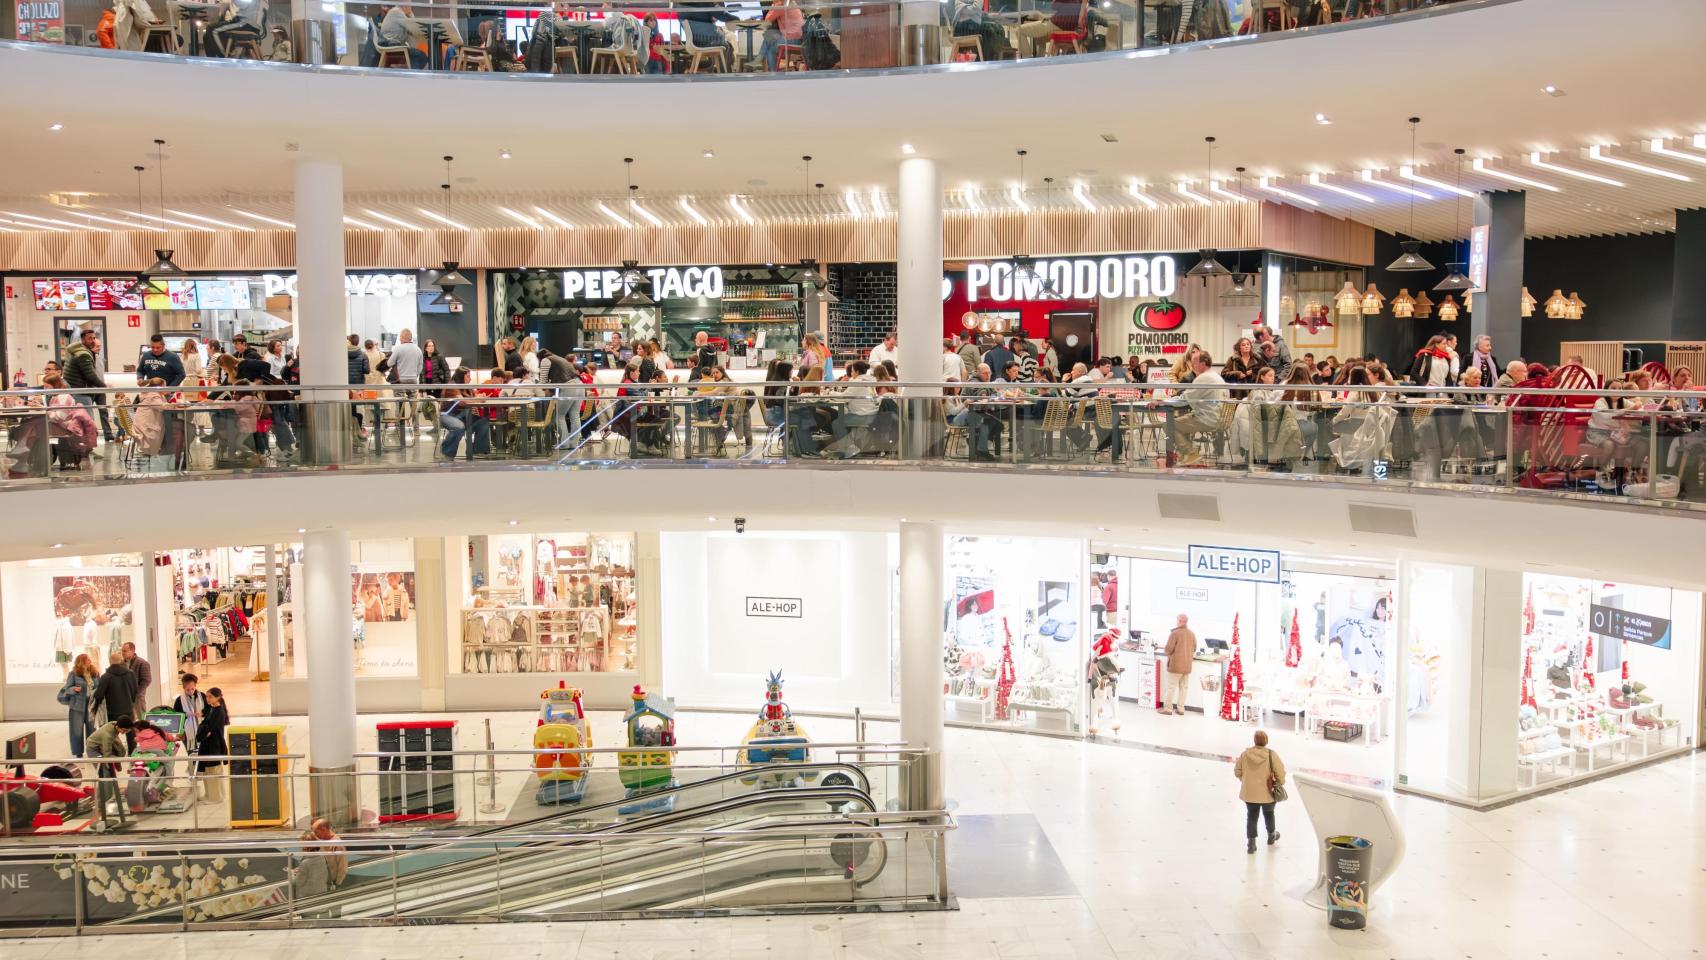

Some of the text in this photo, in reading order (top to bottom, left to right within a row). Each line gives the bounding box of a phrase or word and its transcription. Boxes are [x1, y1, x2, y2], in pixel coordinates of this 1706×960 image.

[648, 266, 724, 301] TACO
[967, 255, 1176, 302] POMODORO
[1128, 332, 1189, 346] POMODORO
[1128, 345, 1144, 356] PIZZA
[1144, 345, 1162, 356] PASTA
[1197, 553, 1272, 574] ALE-HOP
[1179, 589, 1206, 599] ALE-HOP
[751, 602, 797, 613] ALE-HOP
